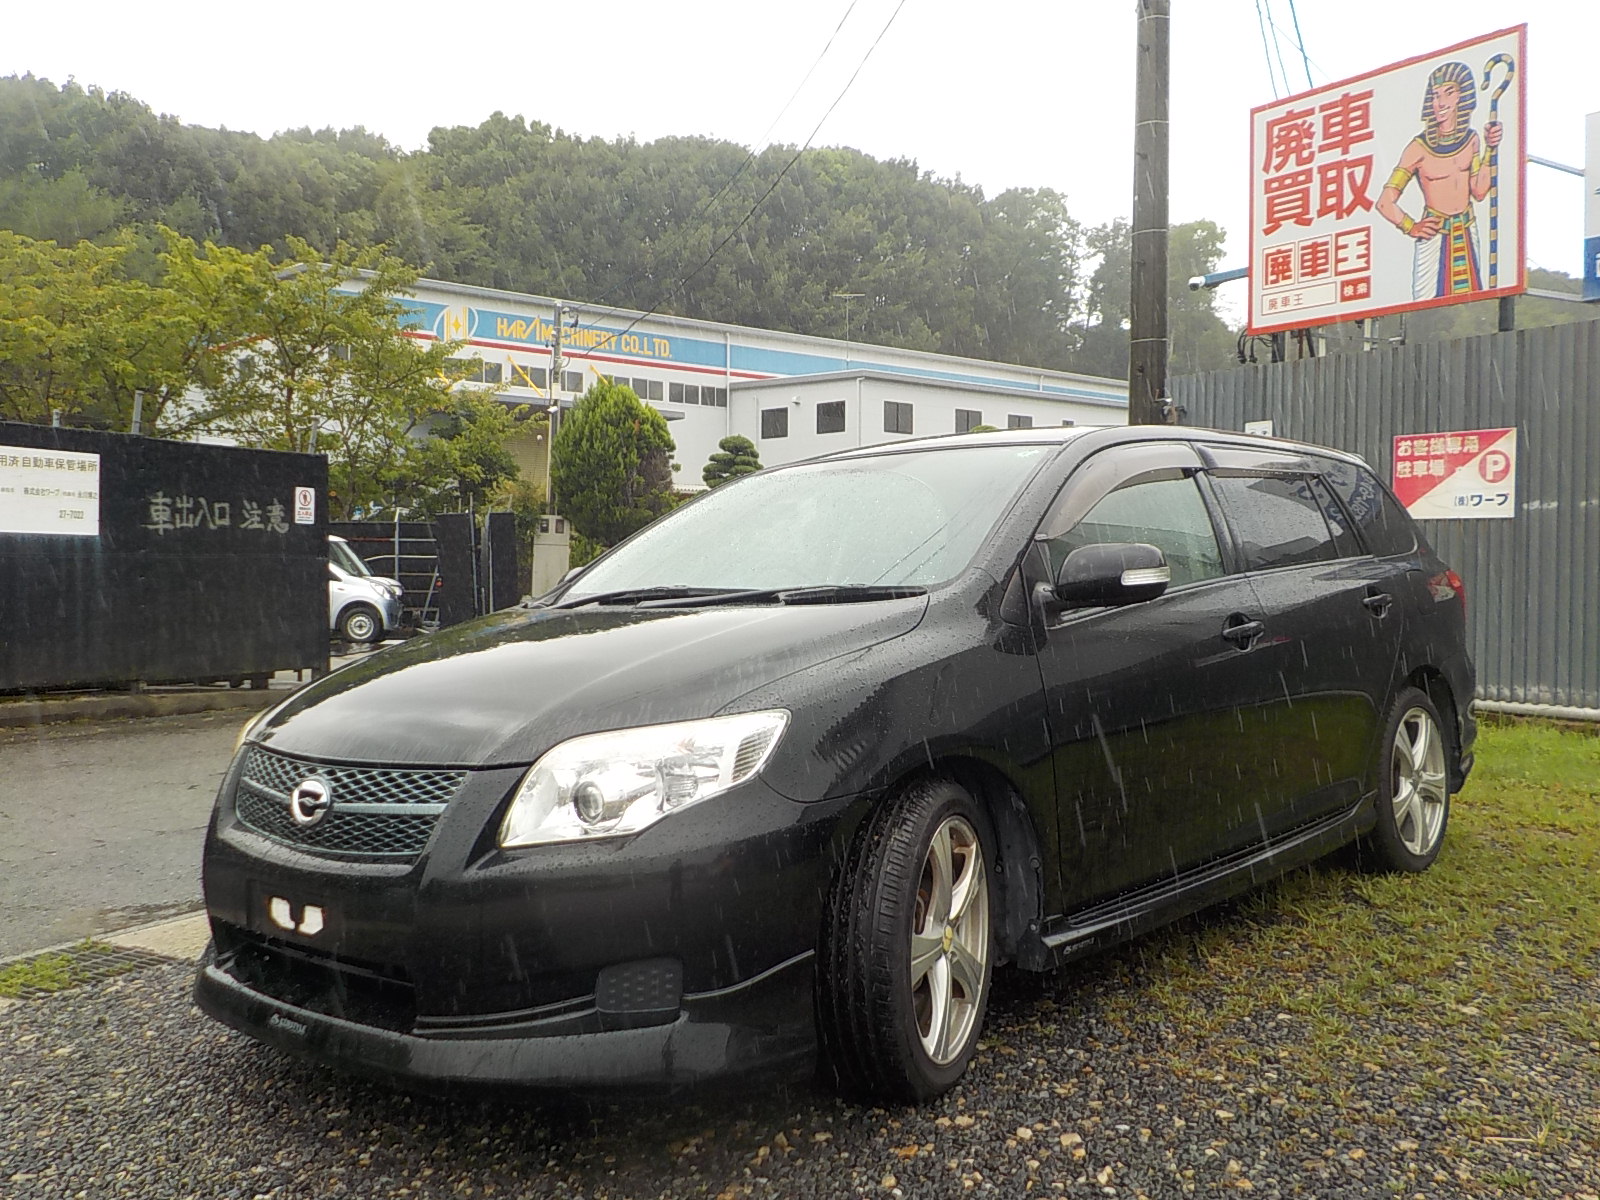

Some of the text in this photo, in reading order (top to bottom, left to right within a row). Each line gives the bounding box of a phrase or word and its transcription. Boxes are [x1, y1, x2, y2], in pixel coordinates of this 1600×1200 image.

[1262, 89, 1374, 174] 廃車
[1262, 154, 1374, 236] 買取
[1397, 435, 1479, 456] お客様専用
[1396, 458, 1445, 478] 駐車場
[141, 491, 289, 535] 車出入口 注意
